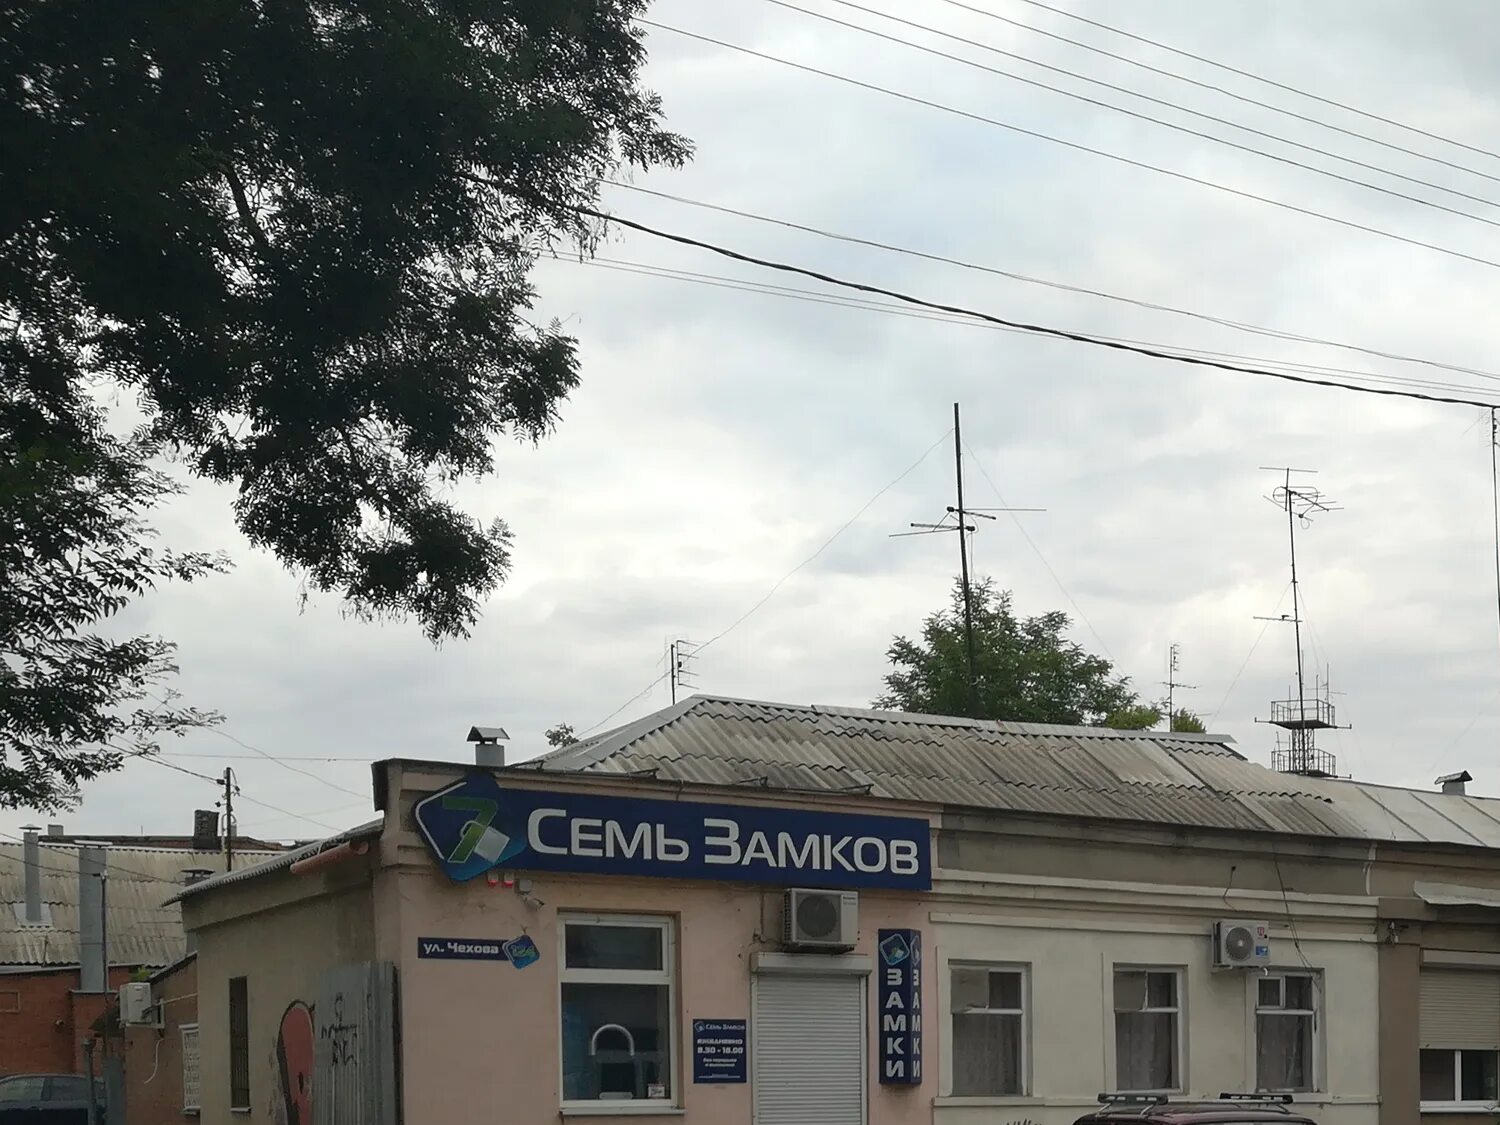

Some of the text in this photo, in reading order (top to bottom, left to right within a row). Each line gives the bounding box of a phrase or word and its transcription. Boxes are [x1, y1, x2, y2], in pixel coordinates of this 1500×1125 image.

[423, 943, 444, 954] ул.
[447, 942, 499, 954] Чехова
[883, 967, 907, 1078] ЗАМКИ
[911, 968, 921, 1079] ЗАМКИ
